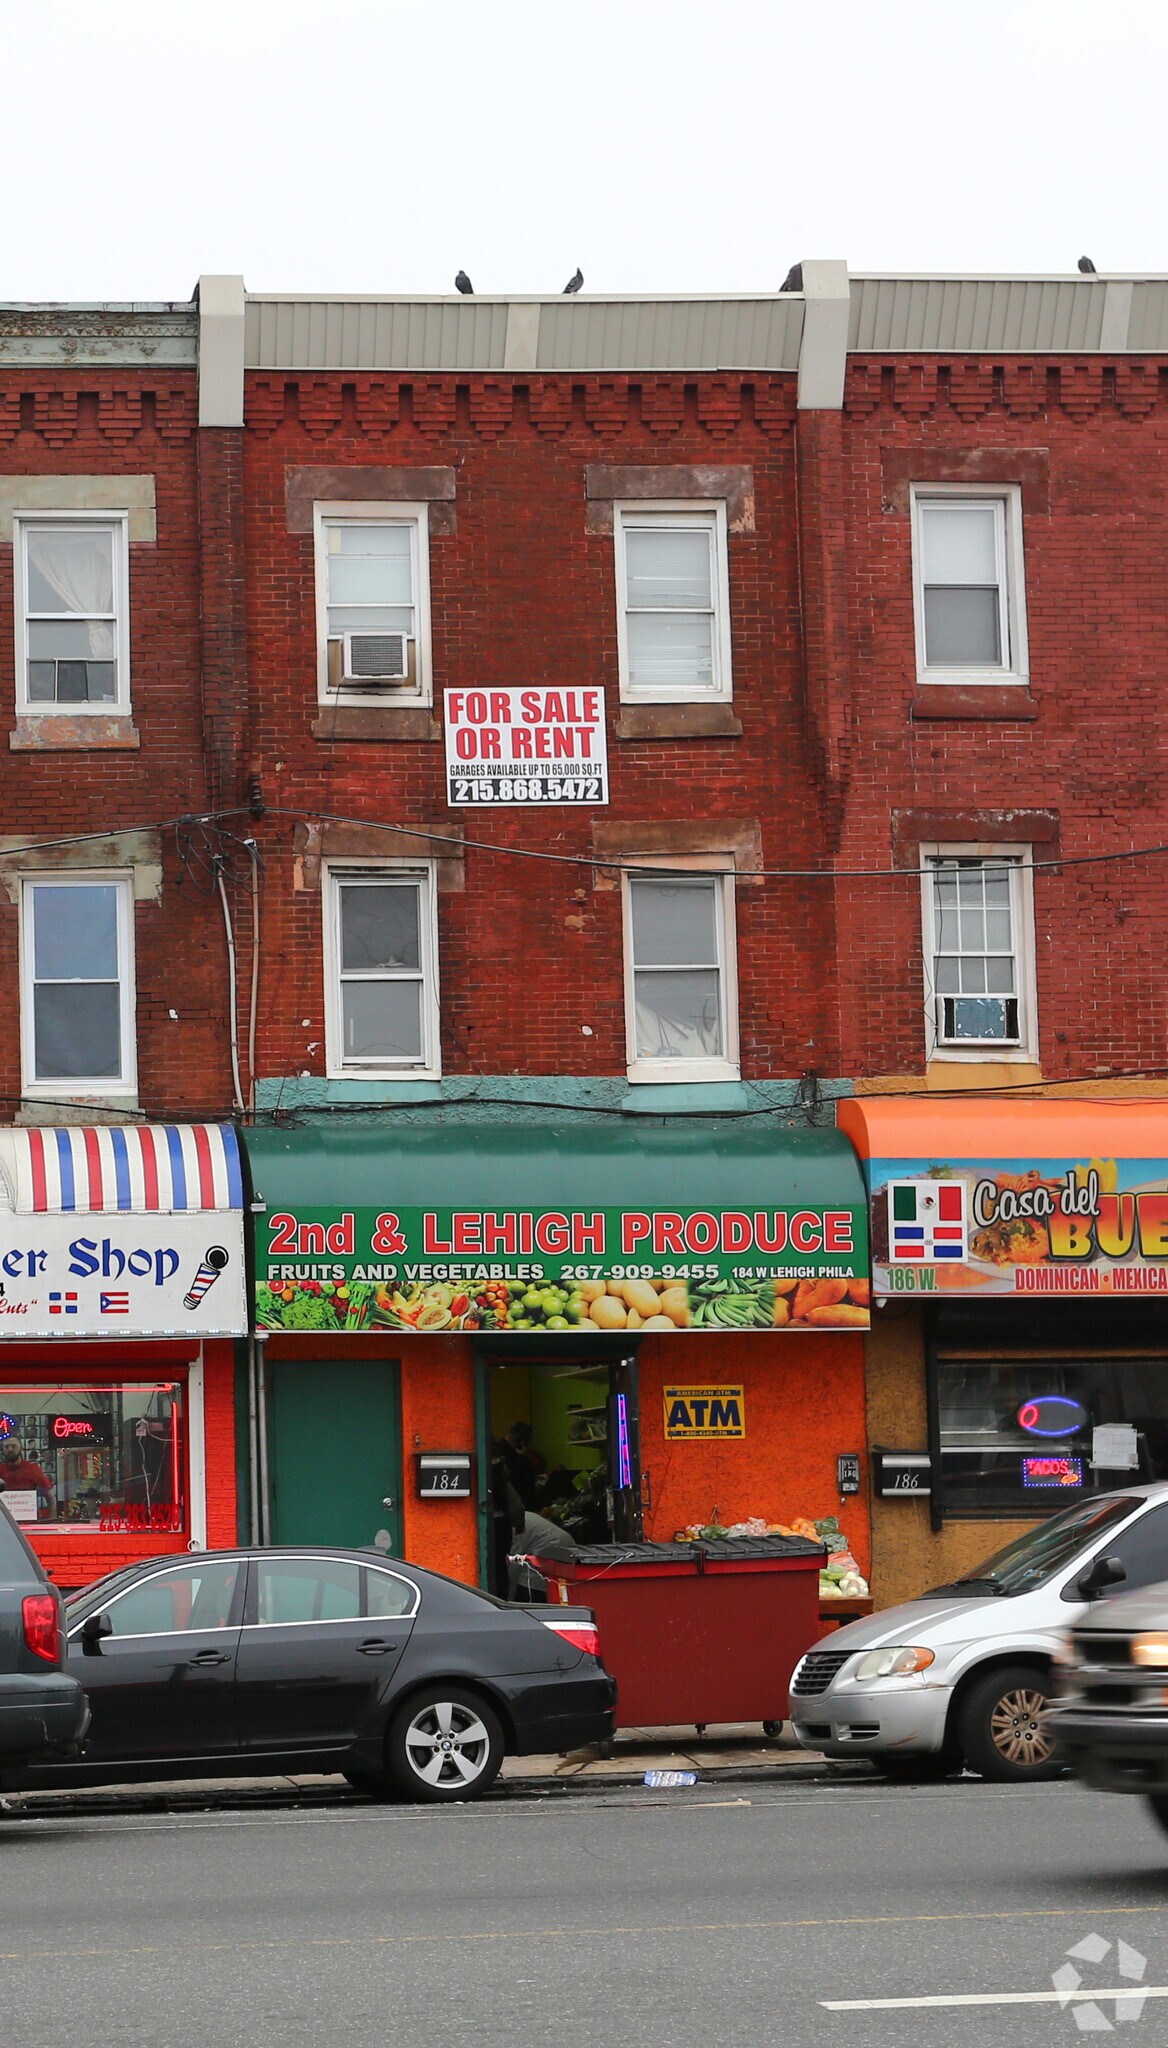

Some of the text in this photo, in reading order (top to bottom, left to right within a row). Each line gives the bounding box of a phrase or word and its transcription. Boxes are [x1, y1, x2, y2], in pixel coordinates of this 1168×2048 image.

[448, 691, 599, 724] FOR SALE
[456, 727, 595, 760] OR RENT
[450, 764, 485, 776] GARAGES
[487, 764, 527, 776] AVAILABLE
[528, 764, 539, 776] UP
[541, 764, 550, 776] TO
[552, 763, 580, 776] 65,000
[455, 779, 599, 801] 215.868.5472
[974, 1169, 1100, 1227] Casa del
[268, 1211, 853, 1255] 2nd & LEHIGH PRODUCE
[68, 1237, 180, 1286] Shop
[267, 1264, 854, 1280] FRUITS AND VEGETABLES 267-909-9455 184 W LEHIGH PHILA
[886, 1268, 938, 1291] 186 W.
[1015, 1268, 1099, 1291] DOMINICAN
[667, 1400, 741, 1427] ATM
[54, 1417, 93, 1437] Open
[1026, 1460, 1069, 1475] TACOS
[432, 1475, 459, 1490] 184
[894, 1474, 919, 1489] 186
